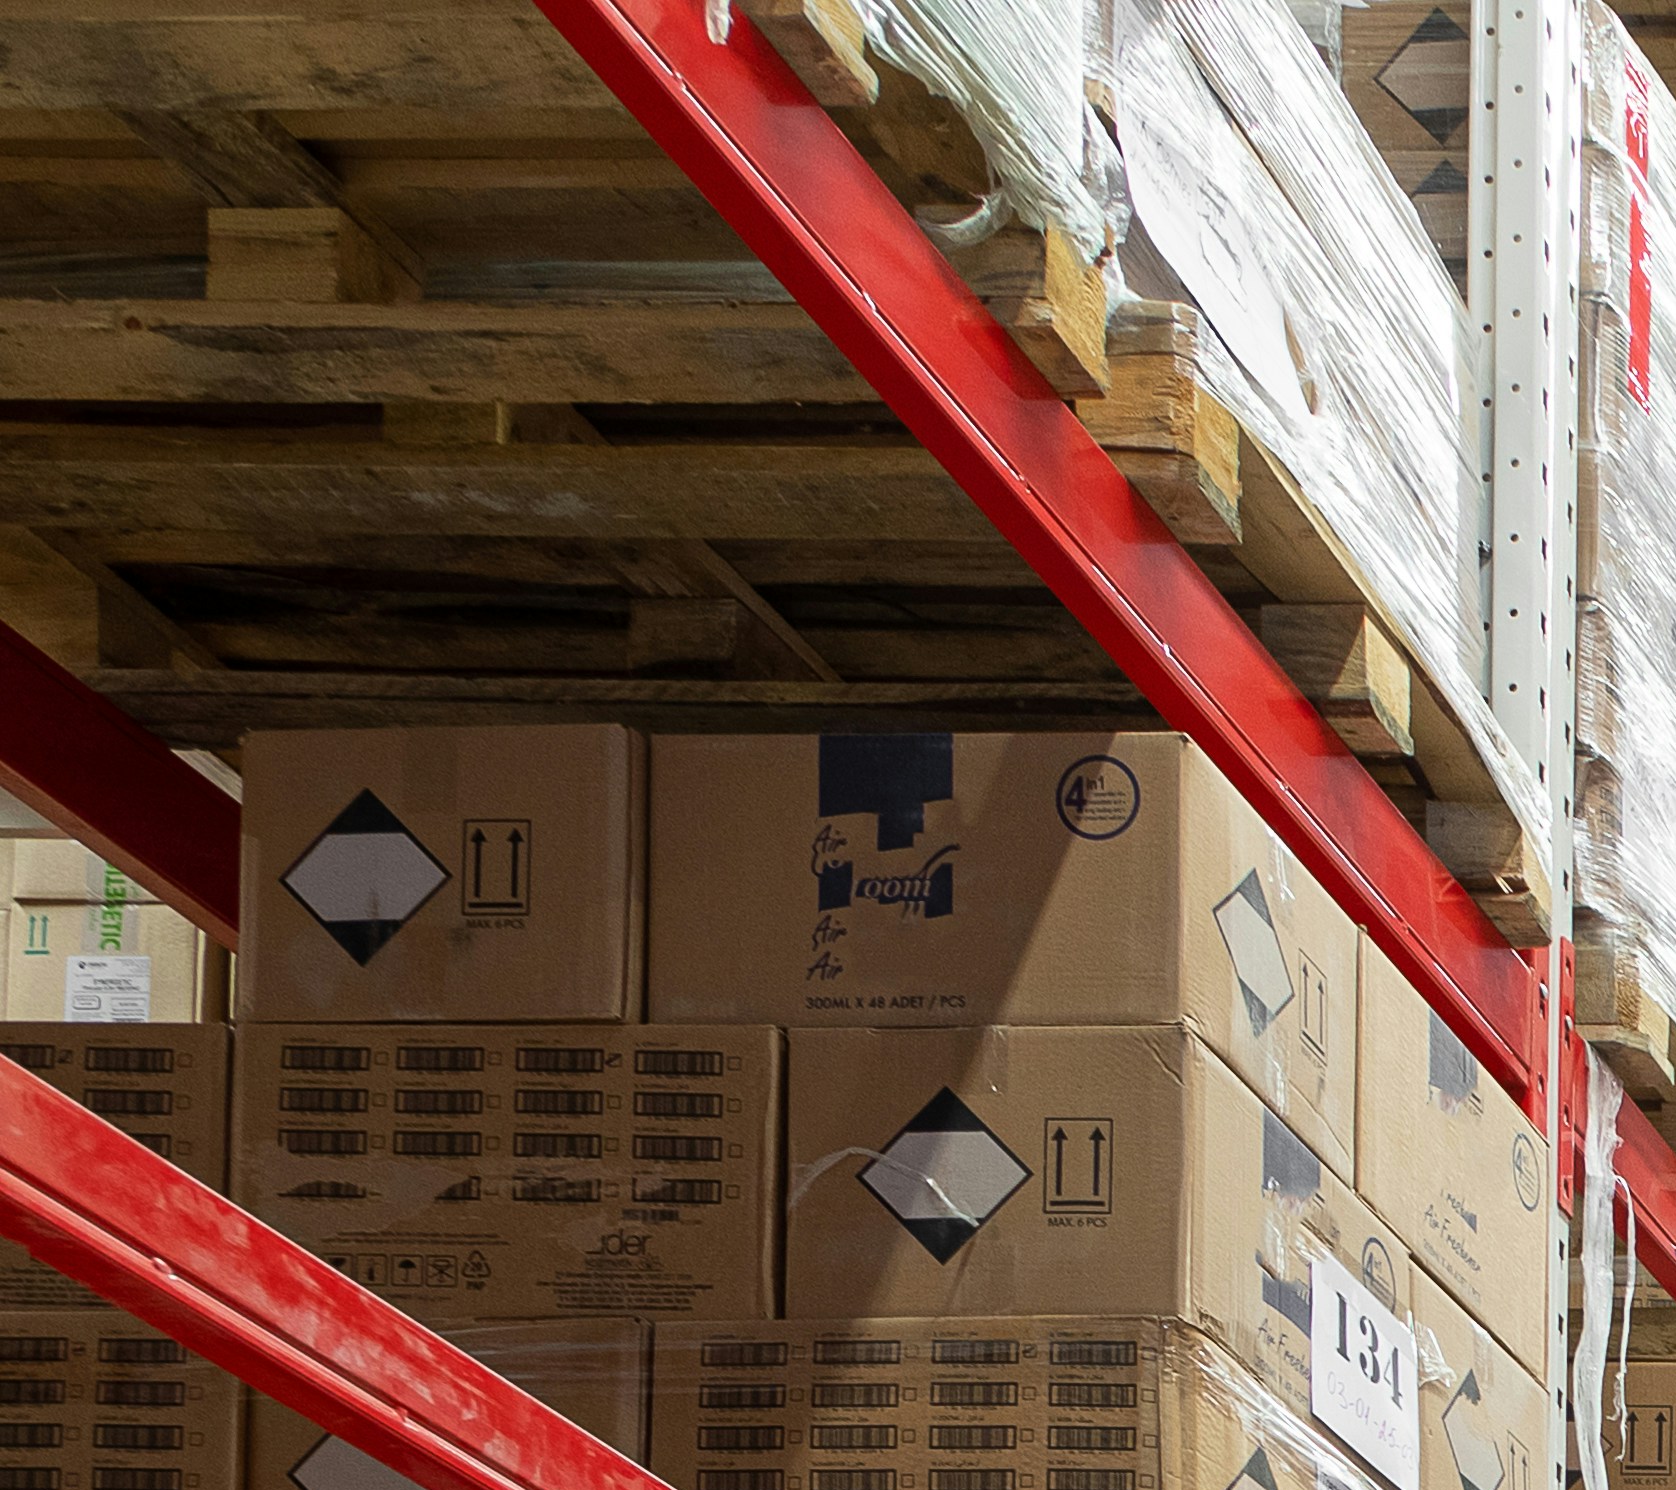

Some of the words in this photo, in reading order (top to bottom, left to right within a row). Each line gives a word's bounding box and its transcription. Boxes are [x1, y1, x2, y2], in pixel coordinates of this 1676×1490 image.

[812, 914, 847, 948] Air
[806, 951, 845, 981] Air
[805, 996, 850, 1010] 300ML
[854, 996, 863, 1010] X
[867, 996, 886, 1010] 48
[889, 996, 927, 1010] ADET
[938, 996, 966, 1010] PCS
[1047, 1217, 1076, 1228] MAX.
[1077, 1217, 1085, 1228] 6
[1086, 1217, 1107, 1228] PCS
[586, 1229, 652, 1256] der
[1332, 1290, 1403, 1410] 134
